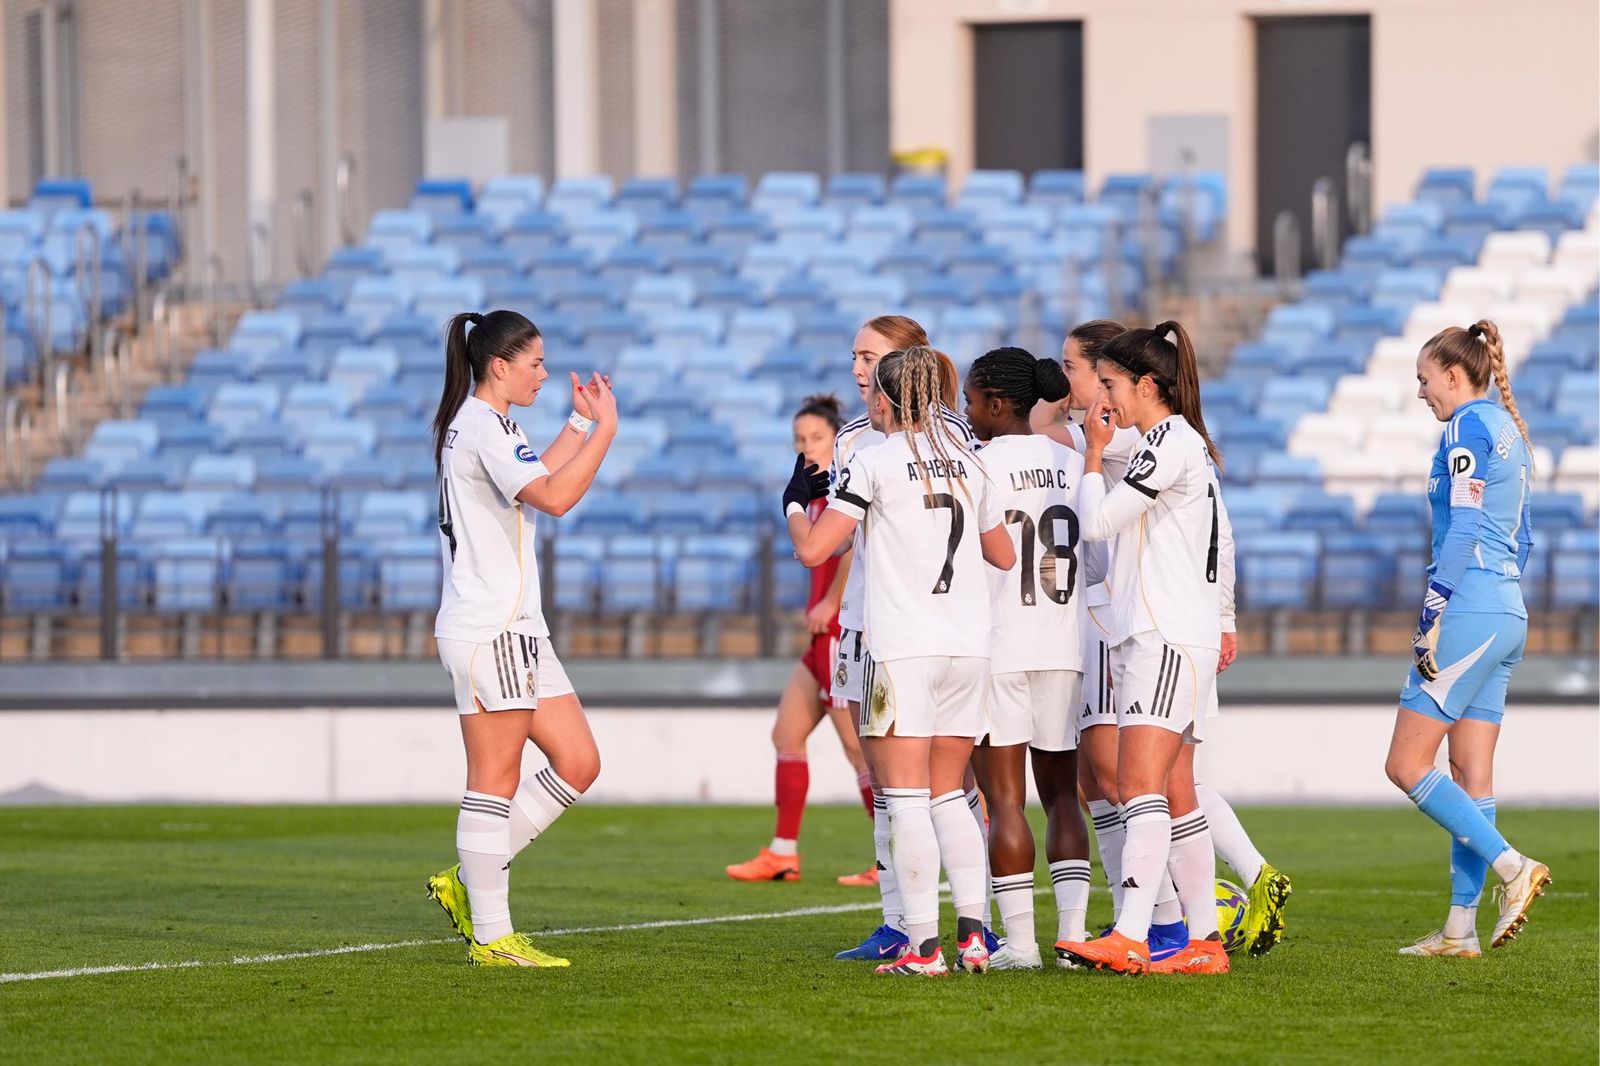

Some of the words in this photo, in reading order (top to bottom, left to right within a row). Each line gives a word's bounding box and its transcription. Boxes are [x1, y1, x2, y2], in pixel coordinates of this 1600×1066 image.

[1010, 468, 1054, 491] LINDA
[1057, 469, 1070, 490] C.
[1451, 455, 1471, 478] JD
[923, 492, 965, 594] 7
[1003, 504, 1080, 606] 18
